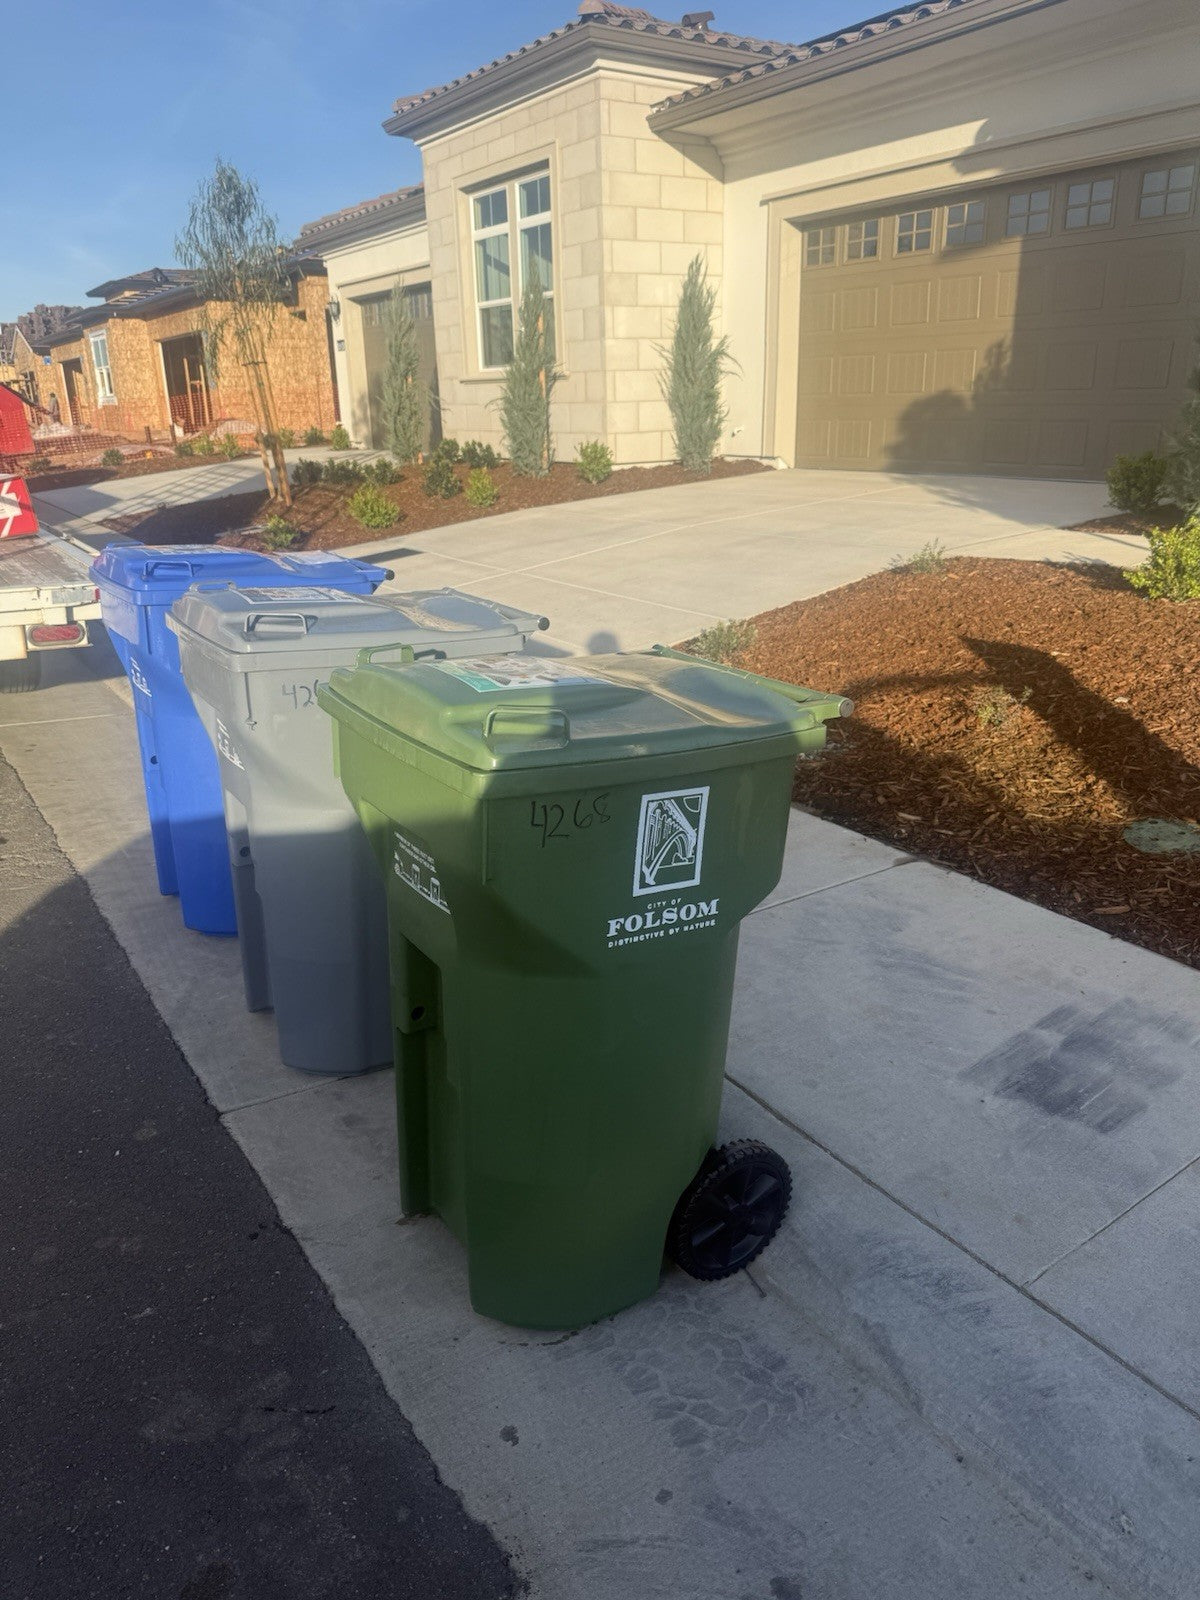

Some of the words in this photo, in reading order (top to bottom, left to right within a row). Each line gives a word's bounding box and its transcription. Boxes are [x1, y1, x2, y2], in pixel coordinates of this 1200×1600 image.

[530, 792, 611, 848] 4268
[606, 898, 720, 937] FOLSOM
[647, 901, 667, 909] CITY
[608, 930, 665, 948] DISTINCTIVE
[669, 927, 680, 935] BY
[683, 919, 716, 932] NATURE
